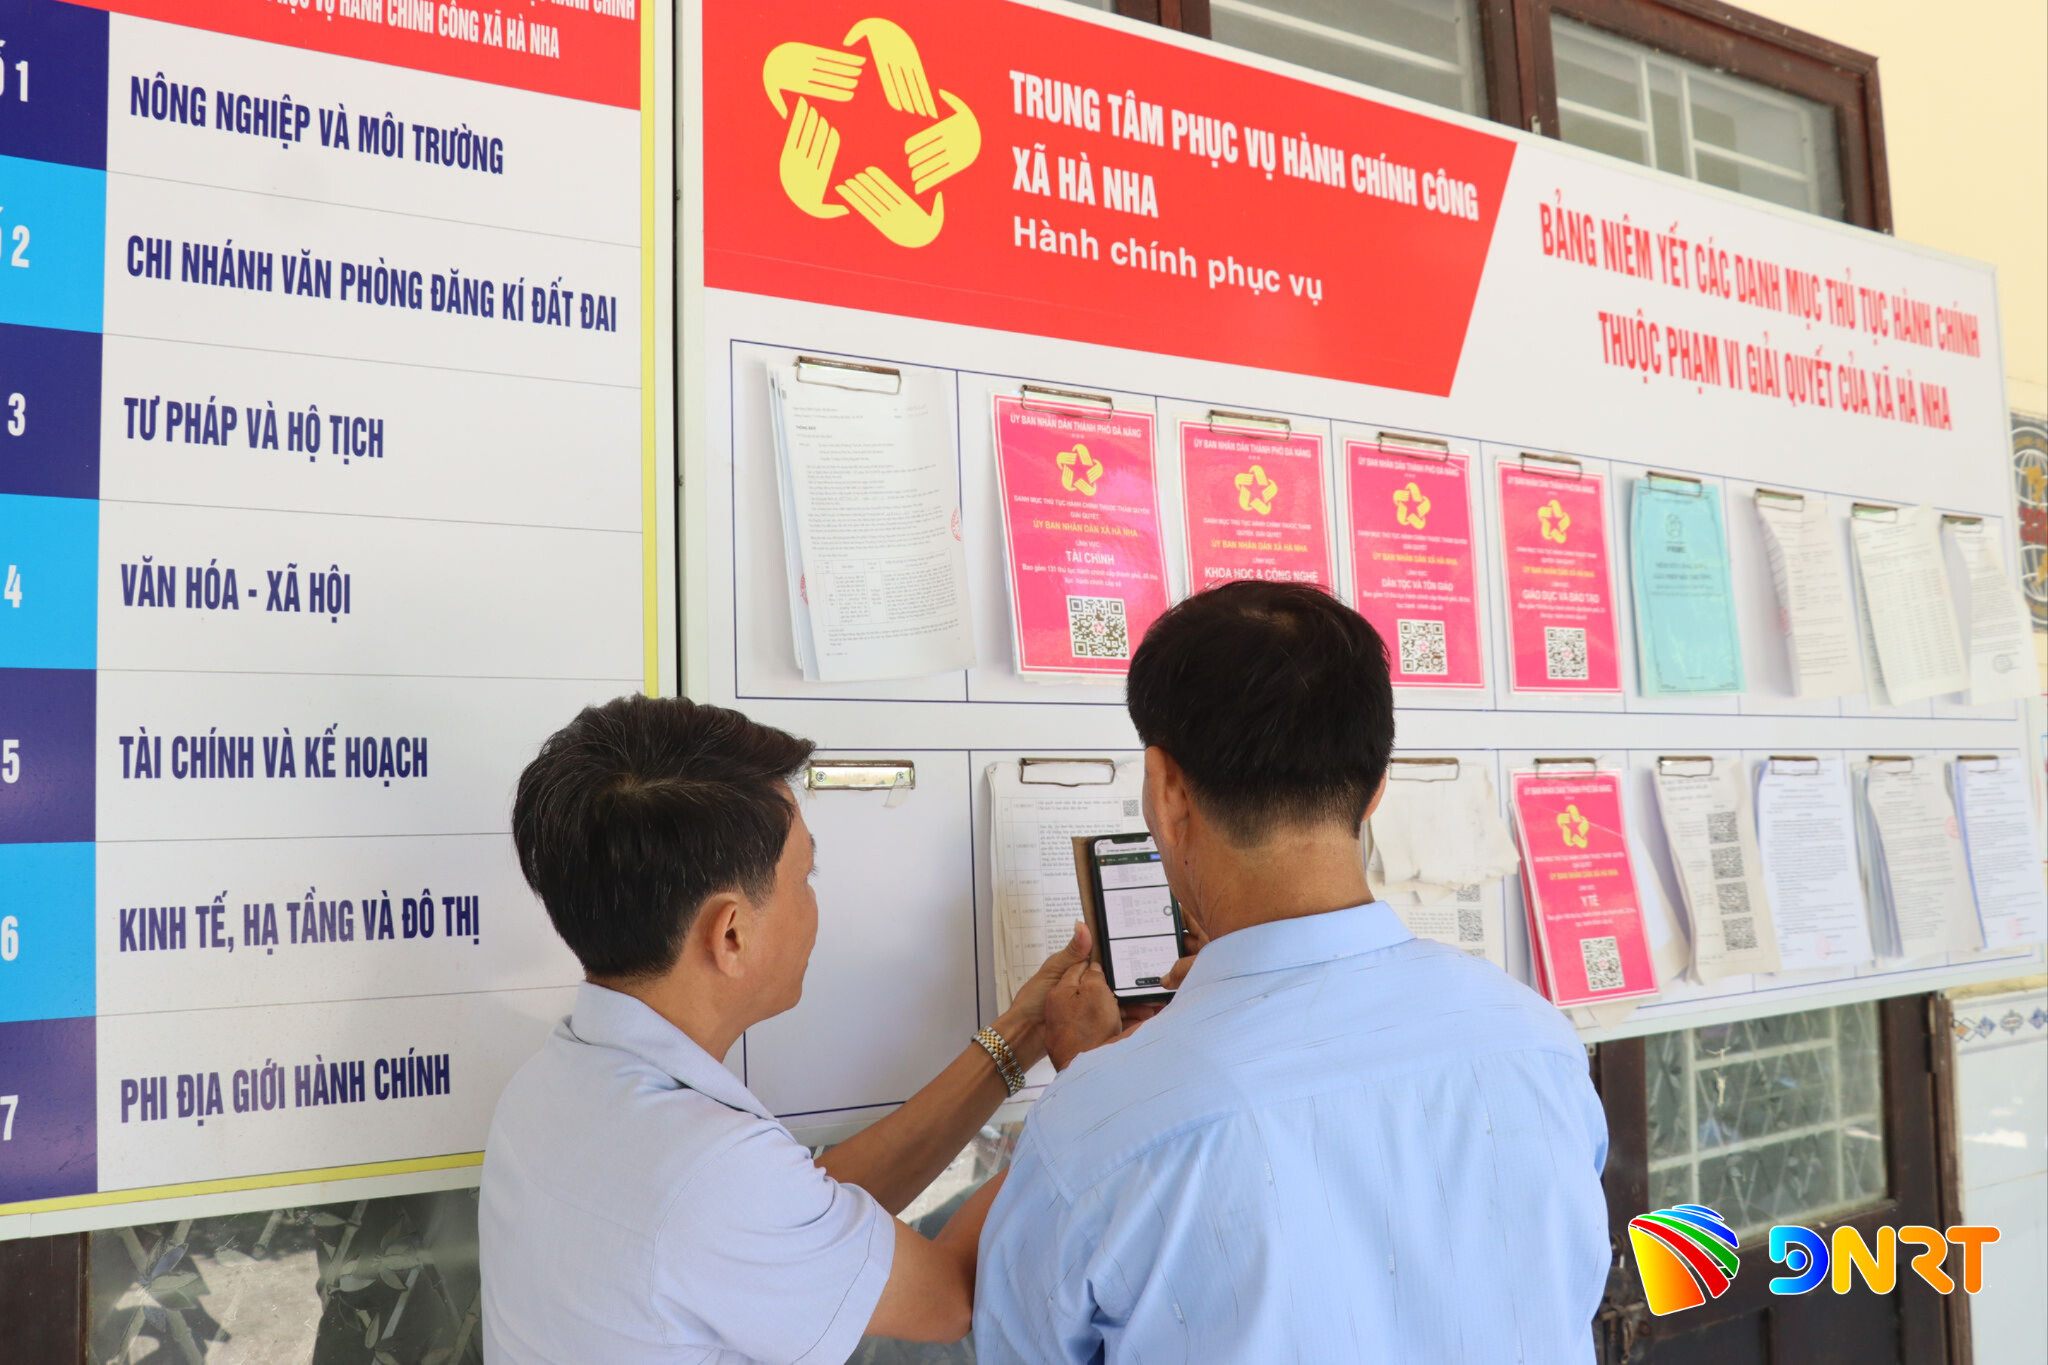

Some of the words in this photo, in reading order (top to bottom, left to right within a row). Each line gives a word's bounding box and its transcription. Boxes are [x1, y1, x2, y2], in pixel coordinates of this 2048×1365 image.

[438, 0, 479, 43] CÔNG
[482, 9, 503, 48] XÃ
[506, 13, 526, 52] HÀ
[530, 22, 560, 59] NHA
[15, 60, 28, 102] 1
[131, 71, 206, 127] NÔNG
[216, 90, 311, 150] NGHIỆP
[319, 103, 350, 150] VÀ
[359, 111, 404, 158] MÔI
[412, 123, 503, 175] TRƯỜNG
[1009, 69, 1100, 132] TRUNG
[1108, 90, 1164, 146] TÂM
[1172, 109, 1238, 168] PHỤC
[1244, 126, 1276, 180] VỤ
[1283, 132, 1346, 189] HÀNH
[1351, 152, 1417, 206] CHÍNH
[1422, 168, 1479, 222] CÔNG
[1013, 142, 1051, 197] XÃ
[1059, 151, 1096, 206] HÀ
[1103, 165, 1159, 219] NHA
[12, 225, 30, 268] 2
[1014, 215, 1099, 261] Hành
[1111, 237, 1197, 279] chính
[1208, 256, 1281, 296] phục
[1289, 273, 1323, 306] vụ
[1539, 188, 1597, 267] BẢNG
[1601, 213, 1653, 281] NIÊM
[1656, 220, 1689, 290] YẾT
[1695, 236, 1730, 300] CÁC
[1734, 254, 1782, 312] DANH
[1785, 267, 1822, 330] MỤC
[1825, 267, 1856, 330] THỦ
[1859, 287, 1889, 346] TỤC
[1892, 286, 1934, 348] HÀNH
[1936, 300, 1981, 358] CHÍNH
[127, 235, 172, 281] CHI
[182, 238, 273, 292] NHÁNH
[281, 249, 332, 299] VĂN
[341, 257, 423, 310] PHÒNG
[431, 268, 494, 318] ĐĂNG
[502, 277, 525, 322] KÍ
[532, 275, 574, 327] ĐẤT
[581, 292, 616, 333] ĐAI
[1598, 308, 1662, 384] THUỘC
[1666, 326, 1722, 395] PHẠM
[1724, 338, 1743, 391] VI
[1746, 330, 1781, 398] GIẢI
[1784, 344, 1833, 407] QUYẾT
[1838, 350, 1871, 416] CỦA
[1872, 365, 1895, 420] XÃ
[1896, 368, 1919, 425] HÀ
[1920, 381, 1952, 431] NHA
[7, 392, 26, 437] 3
[123, 395, 160, 441] TƯ
[166, 395, 238, 447] PHÁP
[246, 400, 279, 450] VÀ
[287, 407, 320, 463] HỘ
[329, 414, 384, 465] TỊCH
[4, 564, 23, 608] 4
[121, 555, 176, 608] VĂN
[186, 558, 239, 610] HÓA
[248, 589, 258, 598] -
[266, 562, 301, 612] XÃ
[309, 564, 351, 624] HỘI
[2, 739, 20, 784] 5
[119, 726, 161, 779] TÀI
[171, 727, 254, 779] CHÍNH
[262, 727, 297, 779] VÀ
[304, 722, 338, 778] KẾ
[345, 736, 428, 787] HOẠCH
[1, 915, 19, 961] 6
[119, 907, 186, 952] KINH
[195, 890, 234, 953] TẾ,
[243, 902, 279, 955] HẠ
[286, 886, 354, 944] TẦNG
[362, 889, 396, 941] VÀ
[402, 887, 435, 940] ĐÔ
[441, 895, 480, 945] THỊ
[1, 1094, 19, 1141] 7
[121, 1076, 168, 1123] PHI
[176, 1072, 224, 1127] ĐỊA
[232, 1058, 286, 1114] GIỚI
[294, 1054, 366, 1108] HÀNH
[373, 1046, 451, 1101] CHÍNH
